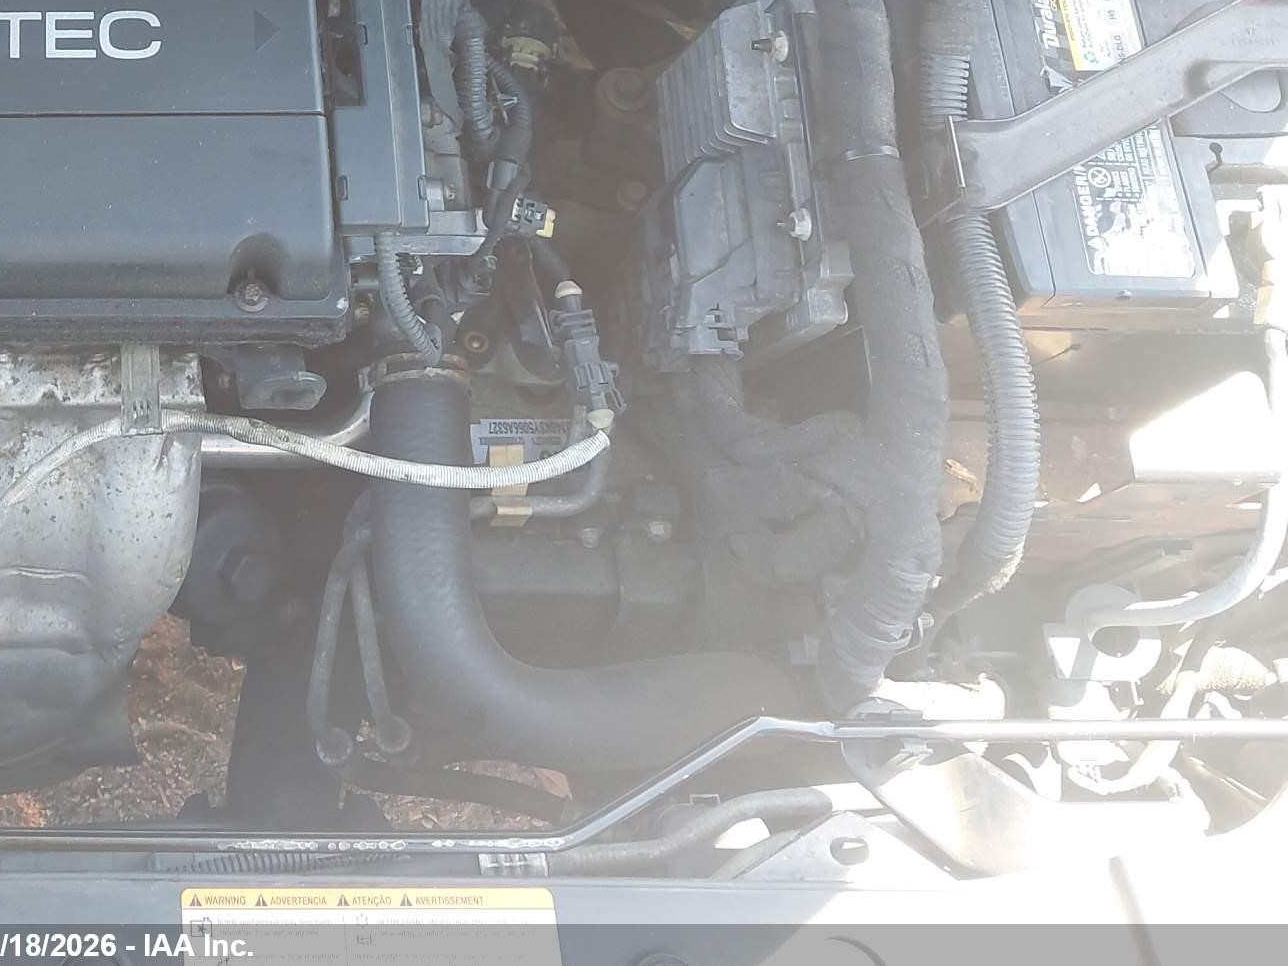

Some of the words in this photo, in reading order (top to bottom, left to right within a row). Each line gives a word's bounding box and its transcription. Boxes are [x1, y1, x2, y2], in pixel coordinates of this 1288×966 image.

[204, 896, 246, 906] WARNING
[270, 896, 327, 906] ADVERTENCIA
[352, 896, 392, 907] ATENÇÃO
[415, 896, 484, 906] AVERTISSEMENT
